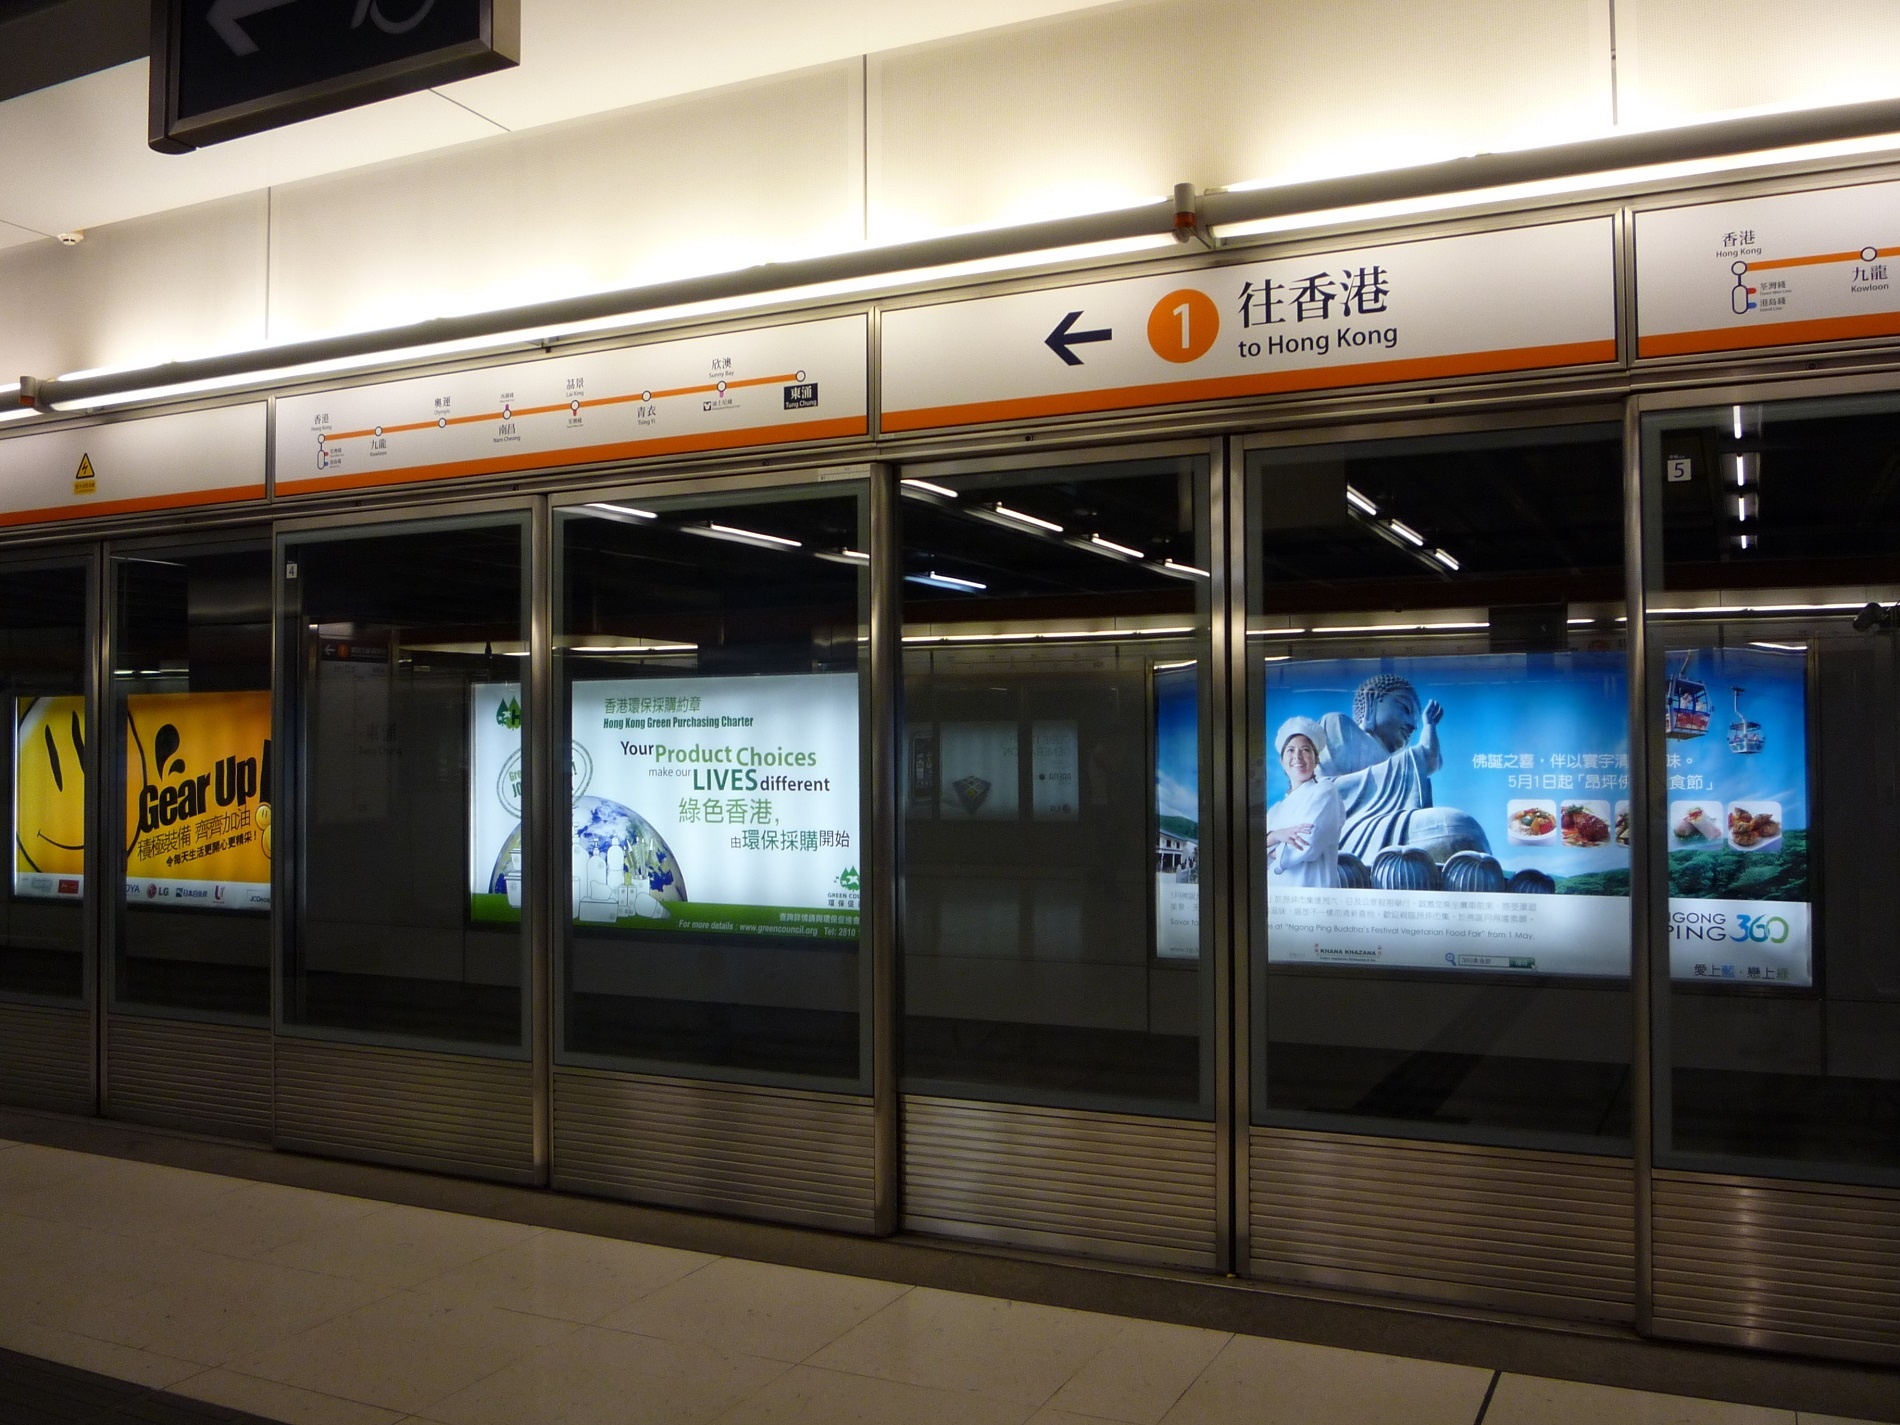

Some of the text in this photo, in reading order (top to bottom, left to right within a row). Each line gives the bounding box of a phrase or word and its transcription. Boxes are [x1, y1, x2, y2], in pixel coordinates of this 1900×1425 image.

[1722, 229, 1756, 247] 香港
[1716, 247, 1762, 258] Hong Kong
[1852, 264, 1888, 283] 九龍
[1850, 283, 1889, 293] Kowloon
[1237, 265, 1391, 329] 往香港
[1172, 303, 1190, 350] 1
[1237, 326, 1398, 358] to Hong Kong
[711, 356, 732, 370] 欣澳
[709, 370, 735, 379] Sunny Bay
[637, 405, 657, 418] 青衣
[785, 399, 817, 409] Tung Chung
[498, 423, 516, 436] 南昌
[637, 419, 650, 427] Tsing
[1674, 462, 1684, 478] 5
[289, 565, 295, 577] 4
[604, 696, 702, 714] 香港環保採購約章
[603, 716, 754, 730] Hong Kong Green Purchasing Charter
[620, 741, 817, 767] Your Product Choices
[648, 767, 830, 792] make our LIVES different
[138, 772, 211, 834] Gear
[137, 824, 191, 863] 積極裝備
[730, 829, 850, 852] 由環保採購開始
[678, 919, 691, 929] For
[692, 921, 710, 930] more
[711, 921, 734, 931] details
[739, 923, 818, 937] www.greencouncil.org
[824, 926, 838, 936] Tel:
[1315, 924, 1332, 936] Ping
[1371, 926, 1399, 935] Festival
[1401, 927, 1444, 938] Vegetarian
[1446, 929, 1466, 937] Food
[1487, 931, 1506, 939] from
[1515, 931, 1536, 941] May.
[1728, 913, 1789, 944] 360
[1344, 949, 1376, 957] KHAZANA
